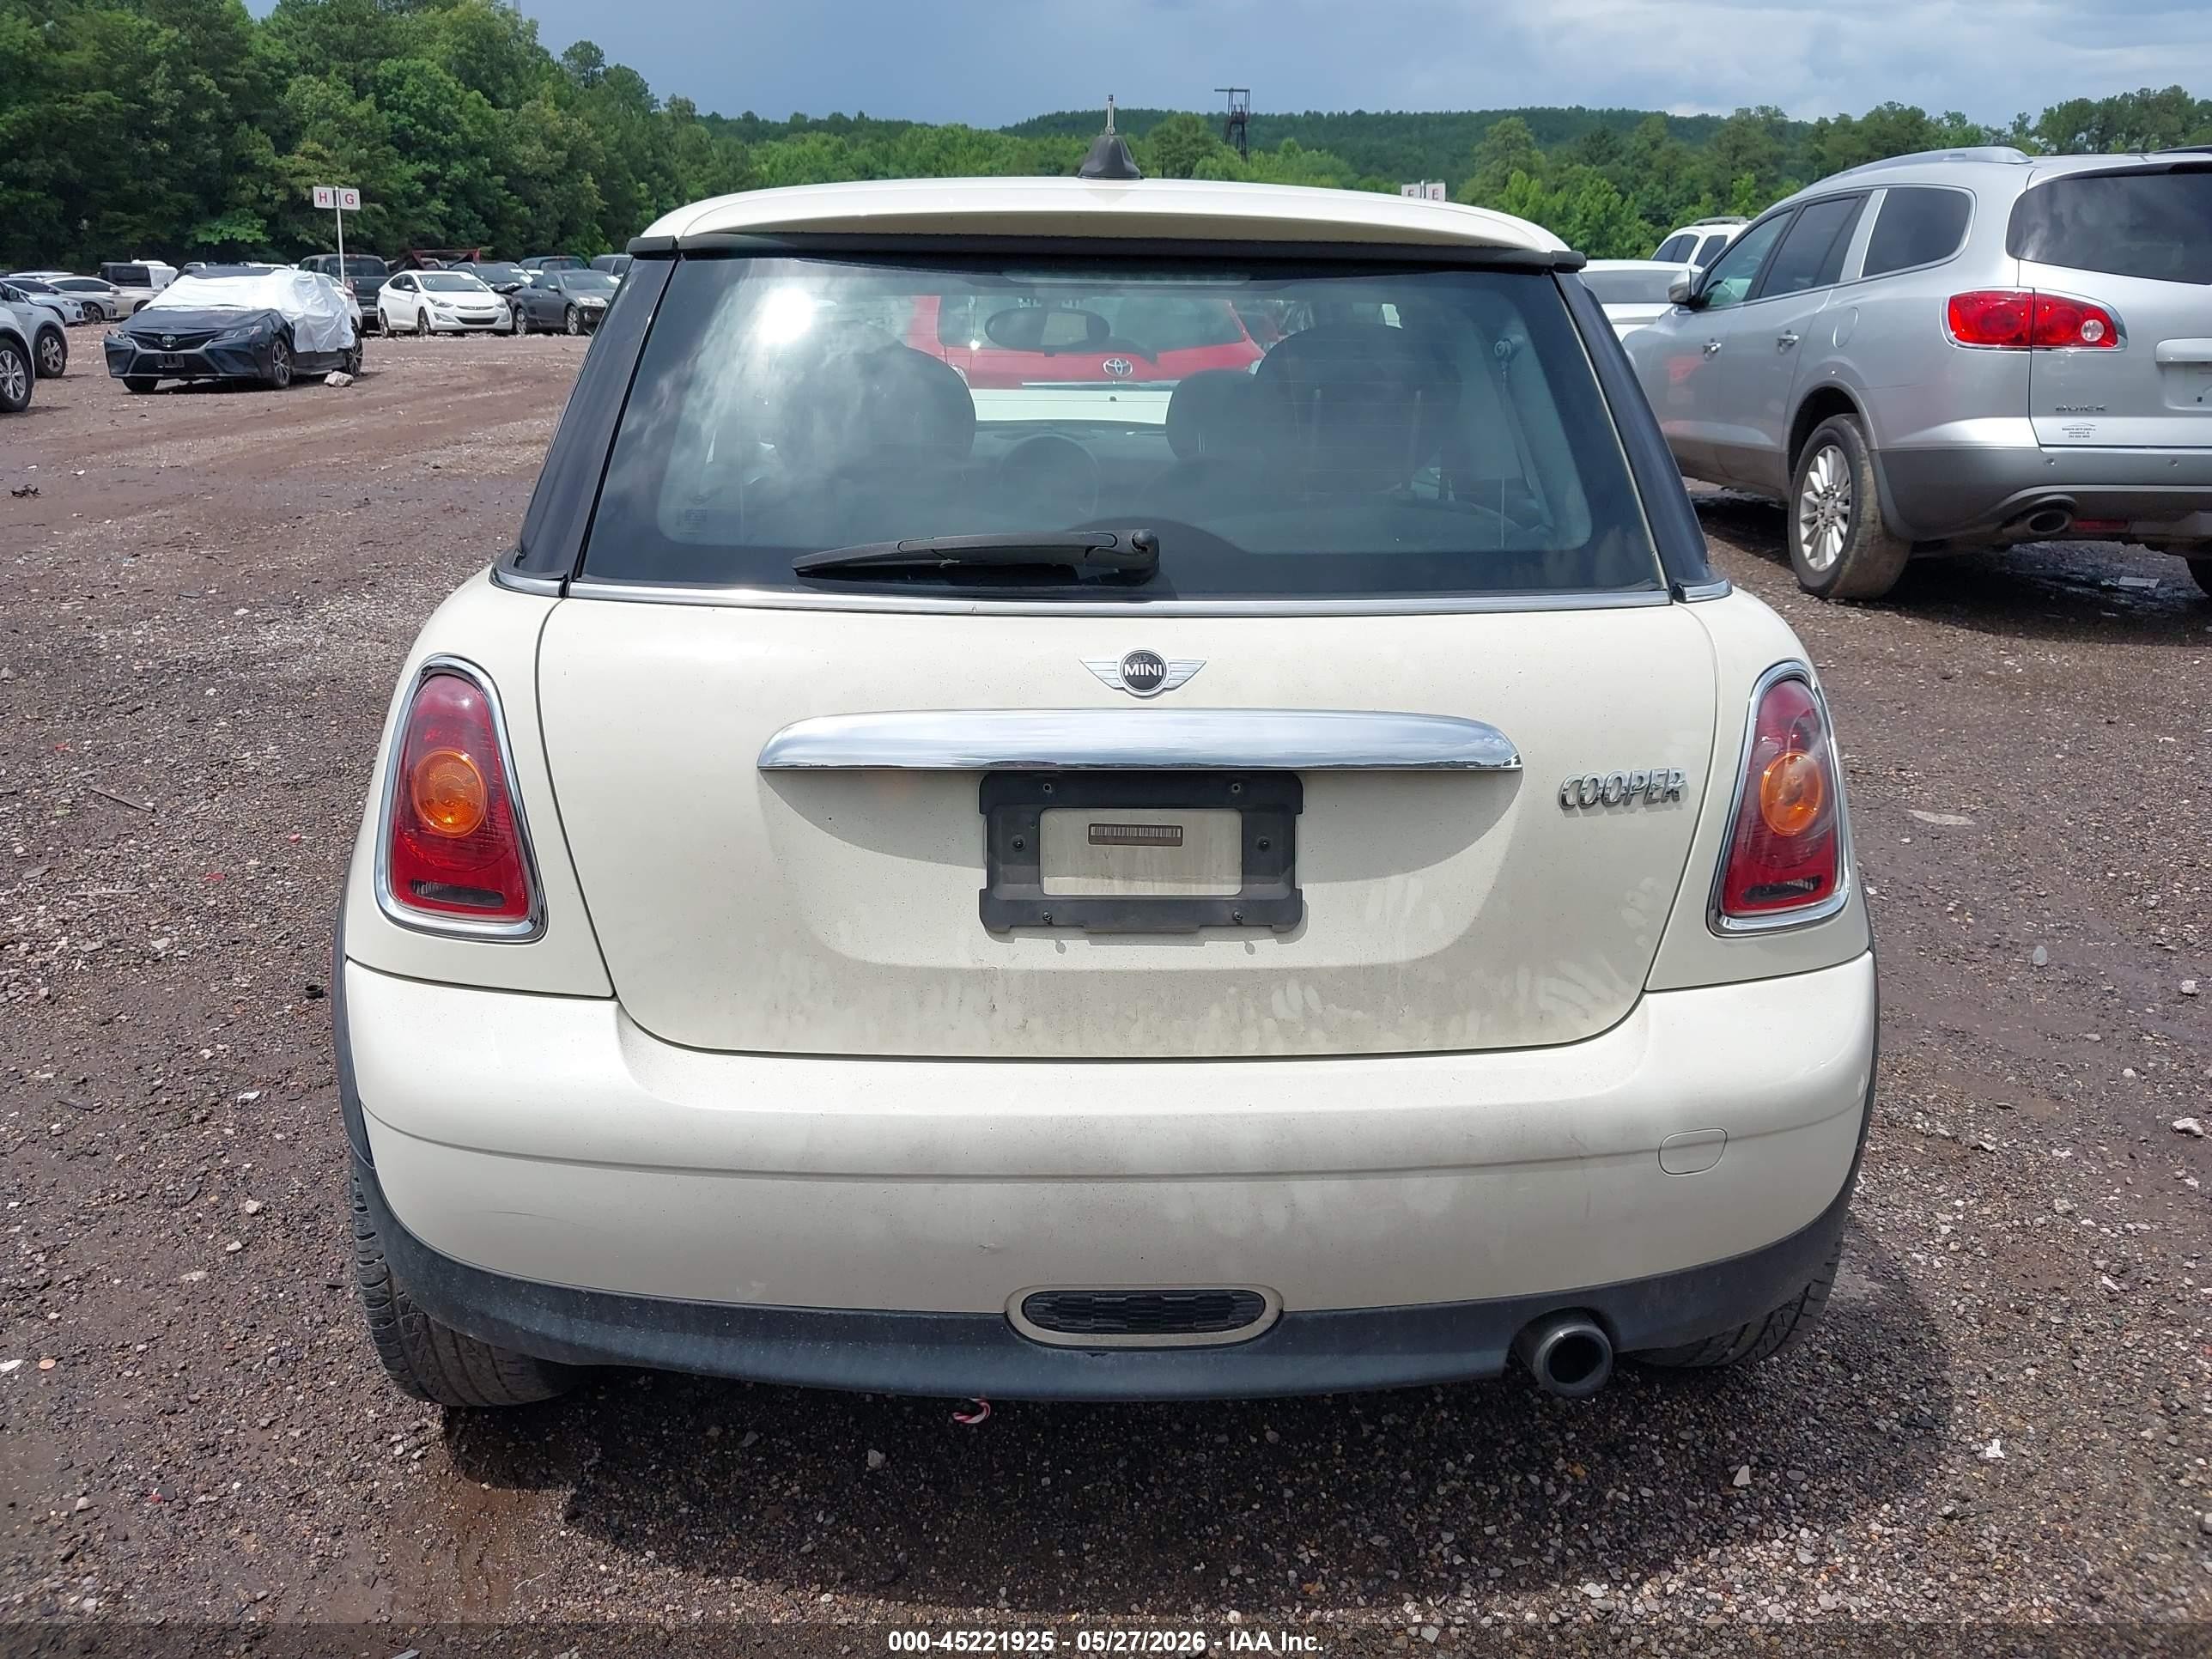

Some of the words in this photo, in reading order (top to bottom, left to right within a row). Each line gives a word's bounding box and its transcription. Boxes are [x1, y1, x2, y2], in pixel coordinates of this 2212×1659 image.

[319, 191, 328, 204] H
[345, 193, 355, 205] G
[1431, 188, 1439, 200] E
[2055, 404, 2107, 412] BUICK
[1124, 663, 1163, 677] MINI
[1559, 767, 1686, 811] COOPER
